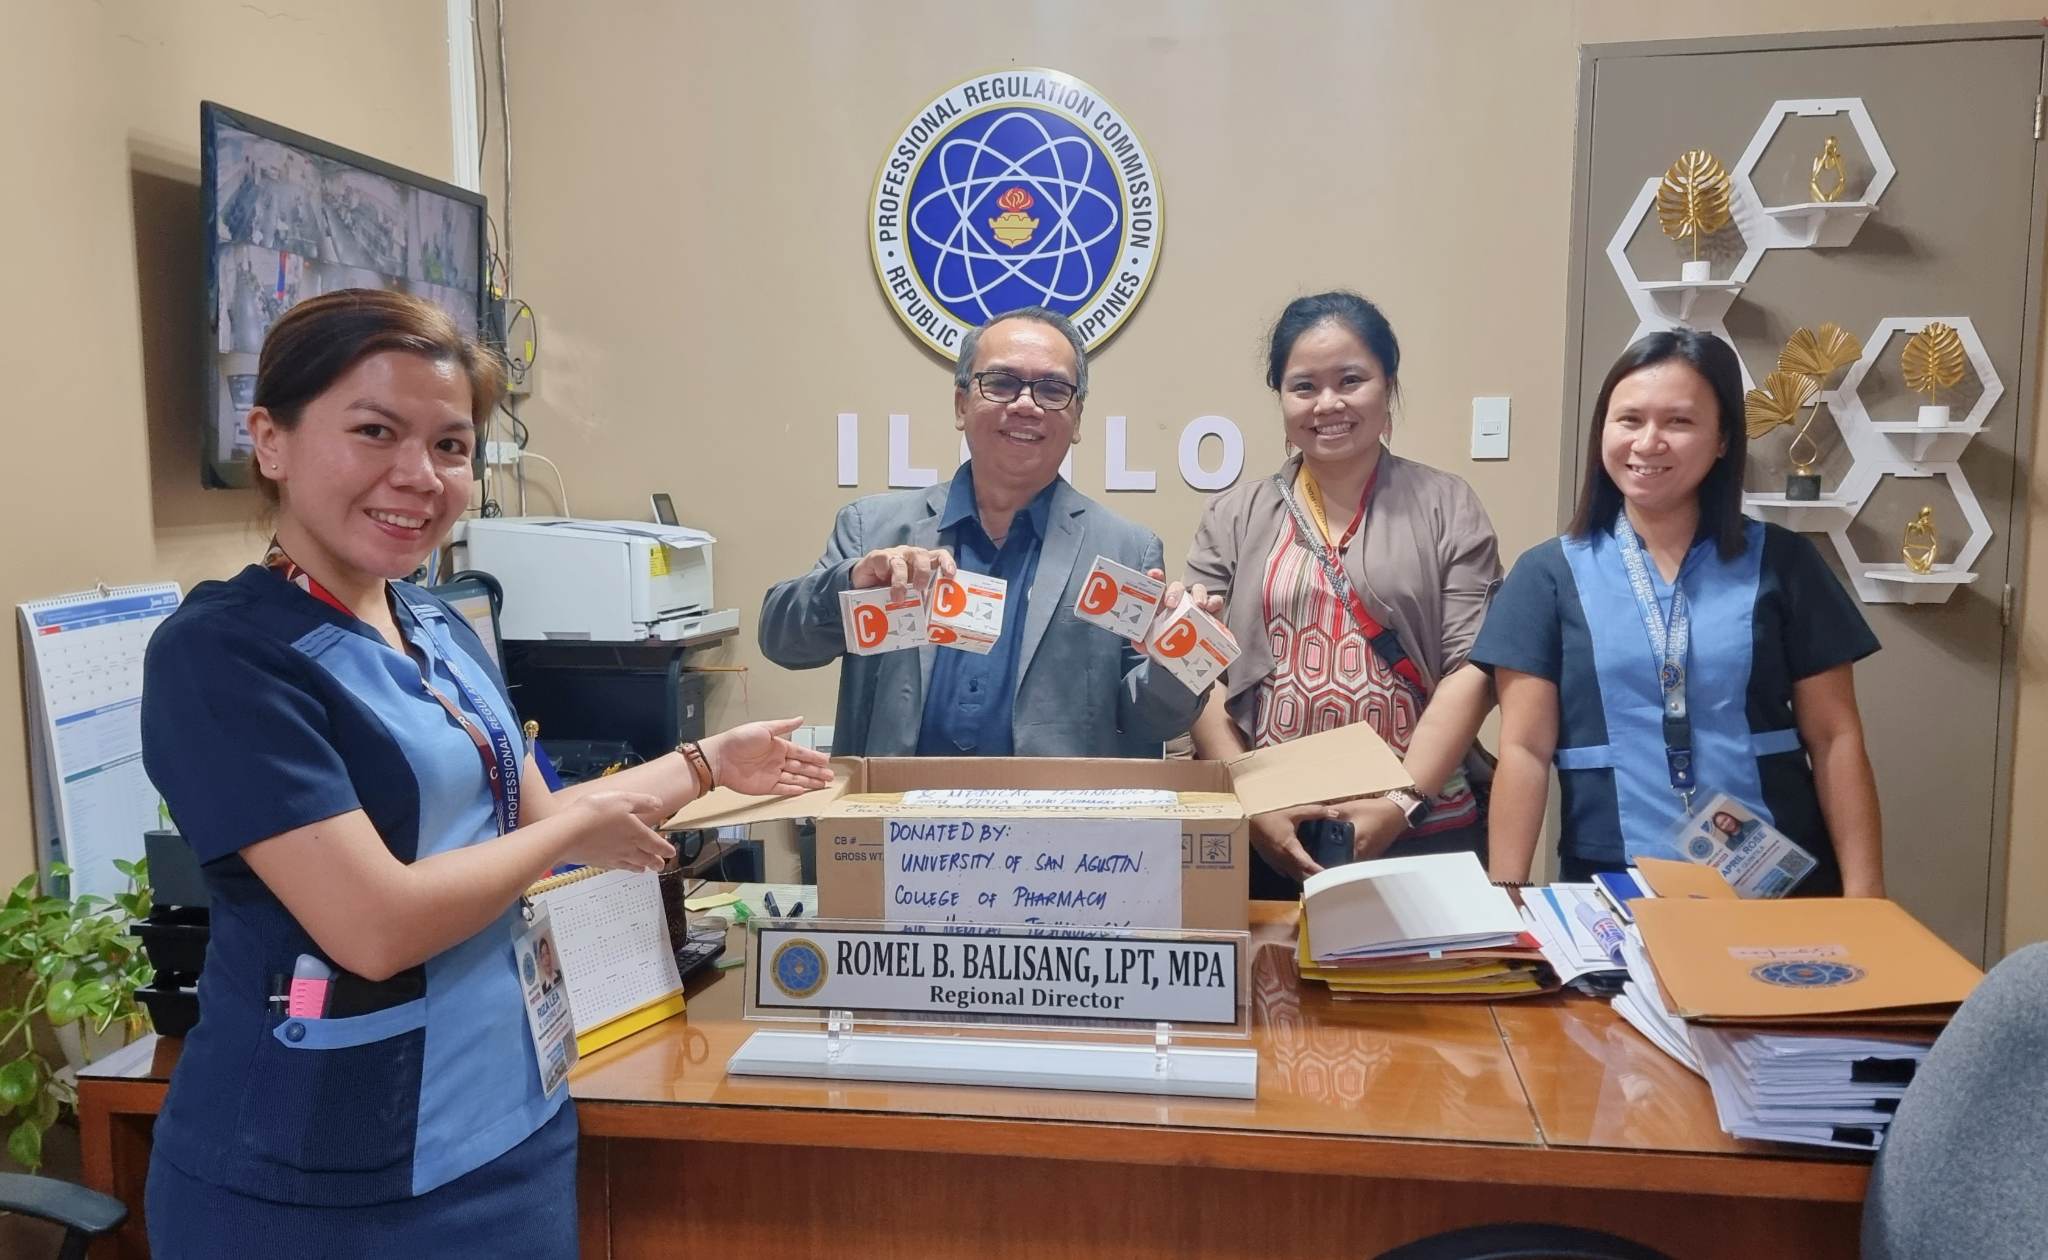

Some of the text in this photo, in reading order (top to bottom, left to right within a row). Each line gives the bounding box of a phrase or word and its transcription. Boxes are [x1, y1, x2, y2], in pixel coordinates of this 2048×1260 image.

[878, 76, 1153, 250] PROFESSIONAL REGULATION COMMISSION
[886, 264, 1141, 348] REPUBLIC IPPINES
[836, 412, 1246, 491] ILLO
[497, 734, 518, 829] PROFESSIONAL
[834, 836, 848, 845] CB
[890, 821, 1011, 843] DONATED BY:
[834, 852, 867, 861] GROSS
[901, 852, 995, 873] UNIVERSITY
[1005, 854, 1023, 874] OF
[1034, 852, 1065, 872] SAN
[1722, 854, 1746, 878] APRIL
[1742, 831, 1768, 855] ROSE
[895, 884, 1107, 910] COLLEGE OF PHARMACY
[836, 940, 925, 977] ROMEL
[932, 943, 955, 978] B.
[962, 943, 1100, 988] BALISANG,
[1104, 948, 1160, 990] LPT,
[1168, 950, 1226, 988] MPA
[930, 985, 1125, 1010] Regional Director
